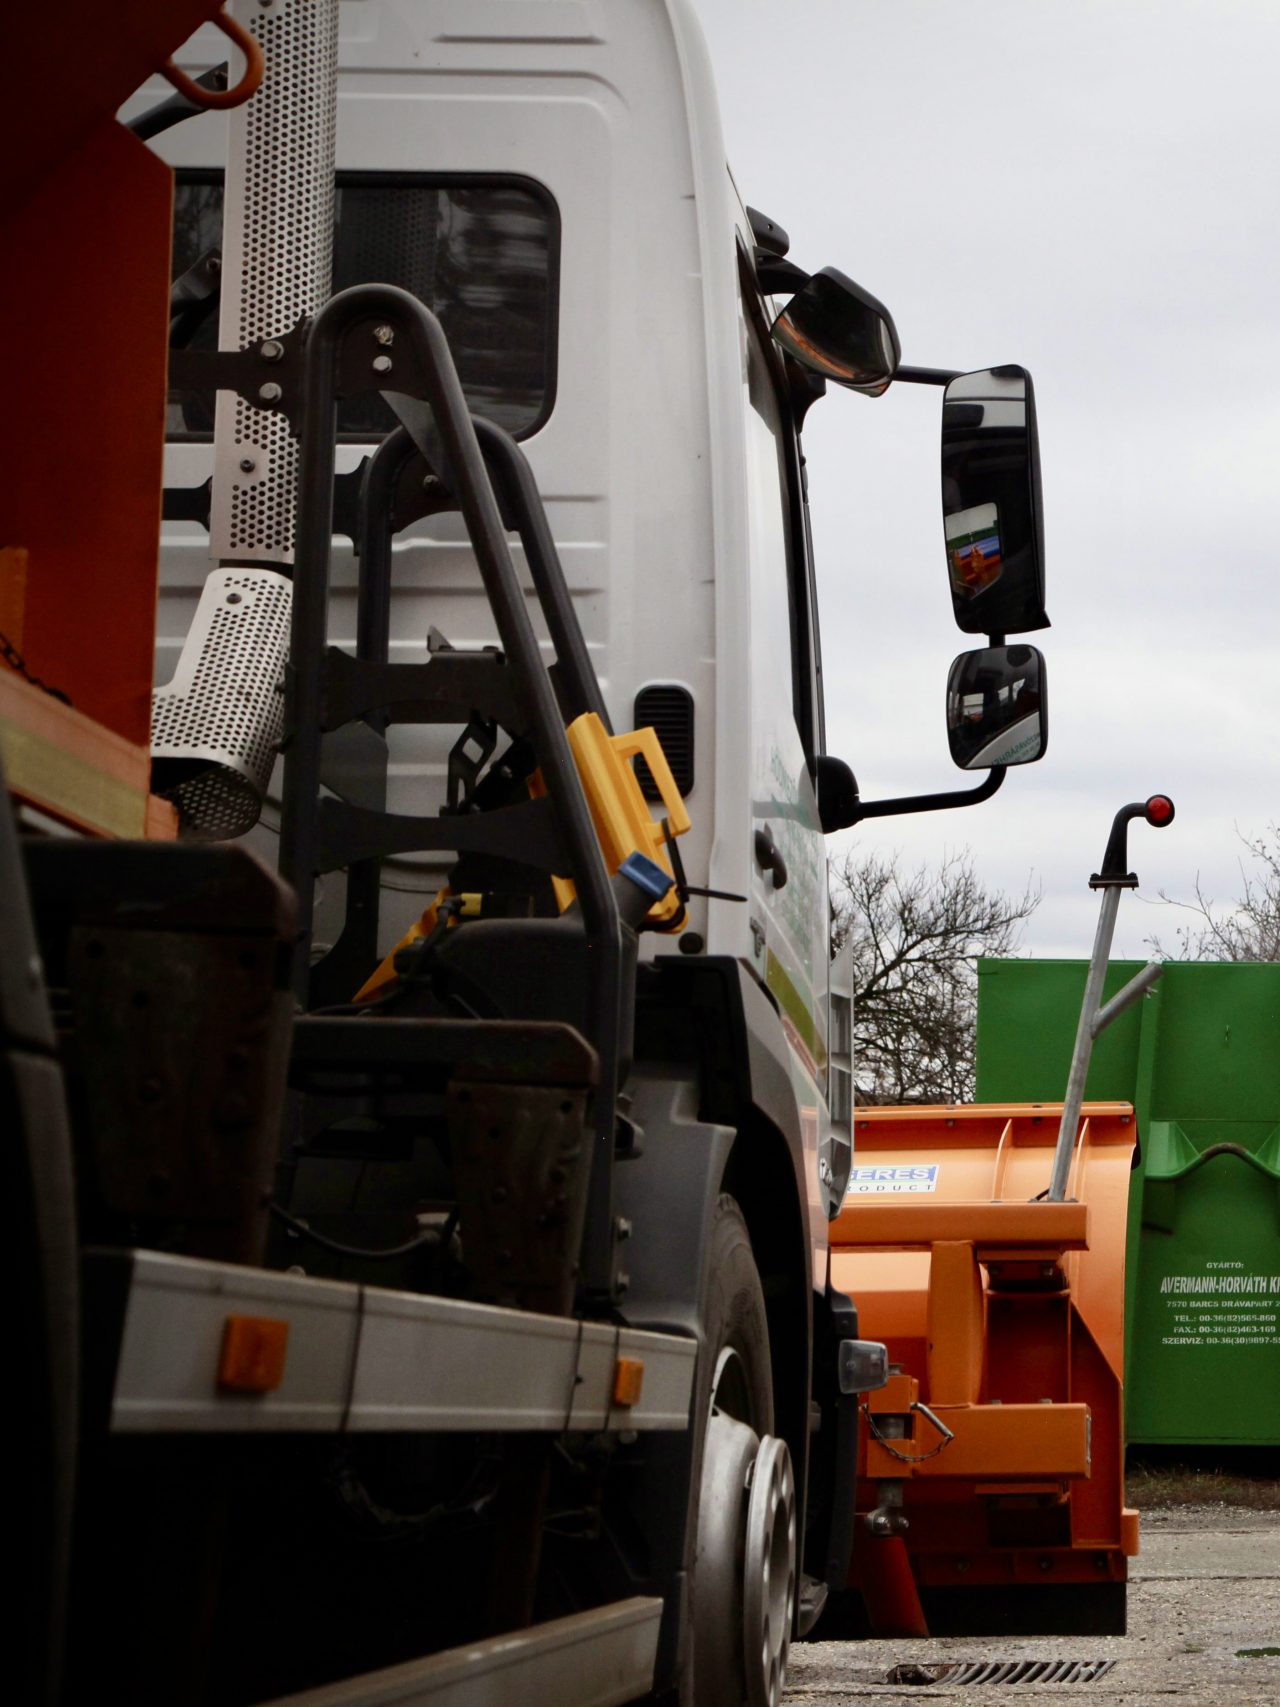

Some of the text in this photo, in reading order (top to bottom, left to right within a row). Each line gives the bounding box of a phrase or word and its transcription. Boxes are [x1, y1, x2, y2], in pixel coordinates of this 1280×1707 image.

[1206, 1260, 1244, 1269] GYÁRTÓ:
[1160, 1272, 1267, 1293] AVERMANN-HORVÁTH
[1167, 1300, 1188, 1308] 7570
[1190, 1300, 1219, 1308] BARCS
[1174, 1314, 1197, 1322] TEL.:
